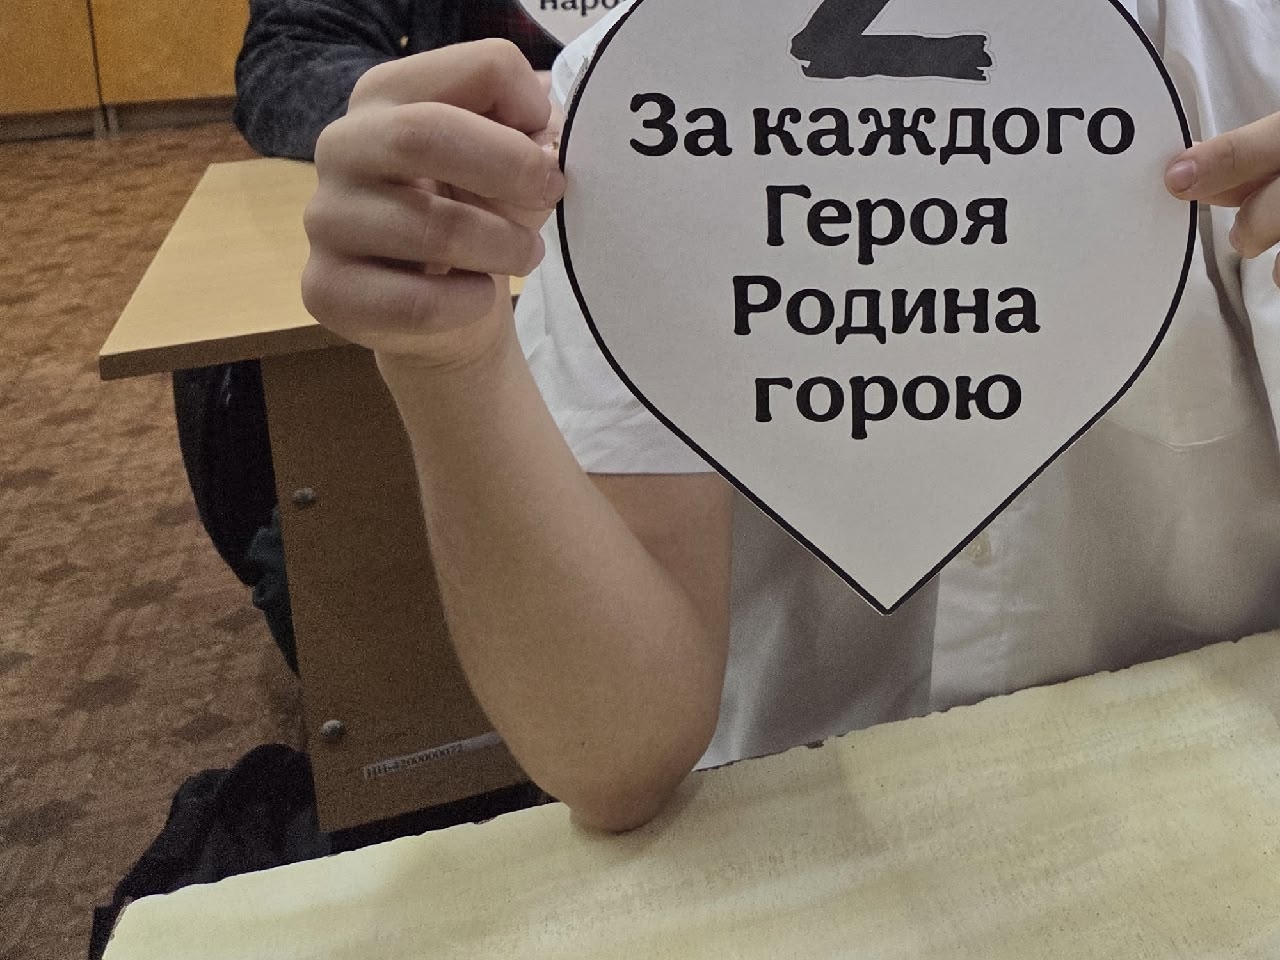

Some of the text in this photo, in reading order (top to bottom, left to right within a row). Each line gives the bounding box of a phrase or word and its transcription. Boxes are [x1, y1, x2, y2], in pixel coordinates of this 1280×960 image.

[629, 92, 1136, 166] За каждого
[766, 184, 1009, 265] Героя
[732, 275, 1041, 345] Родина
[754, 374, 1023, 440] горою
